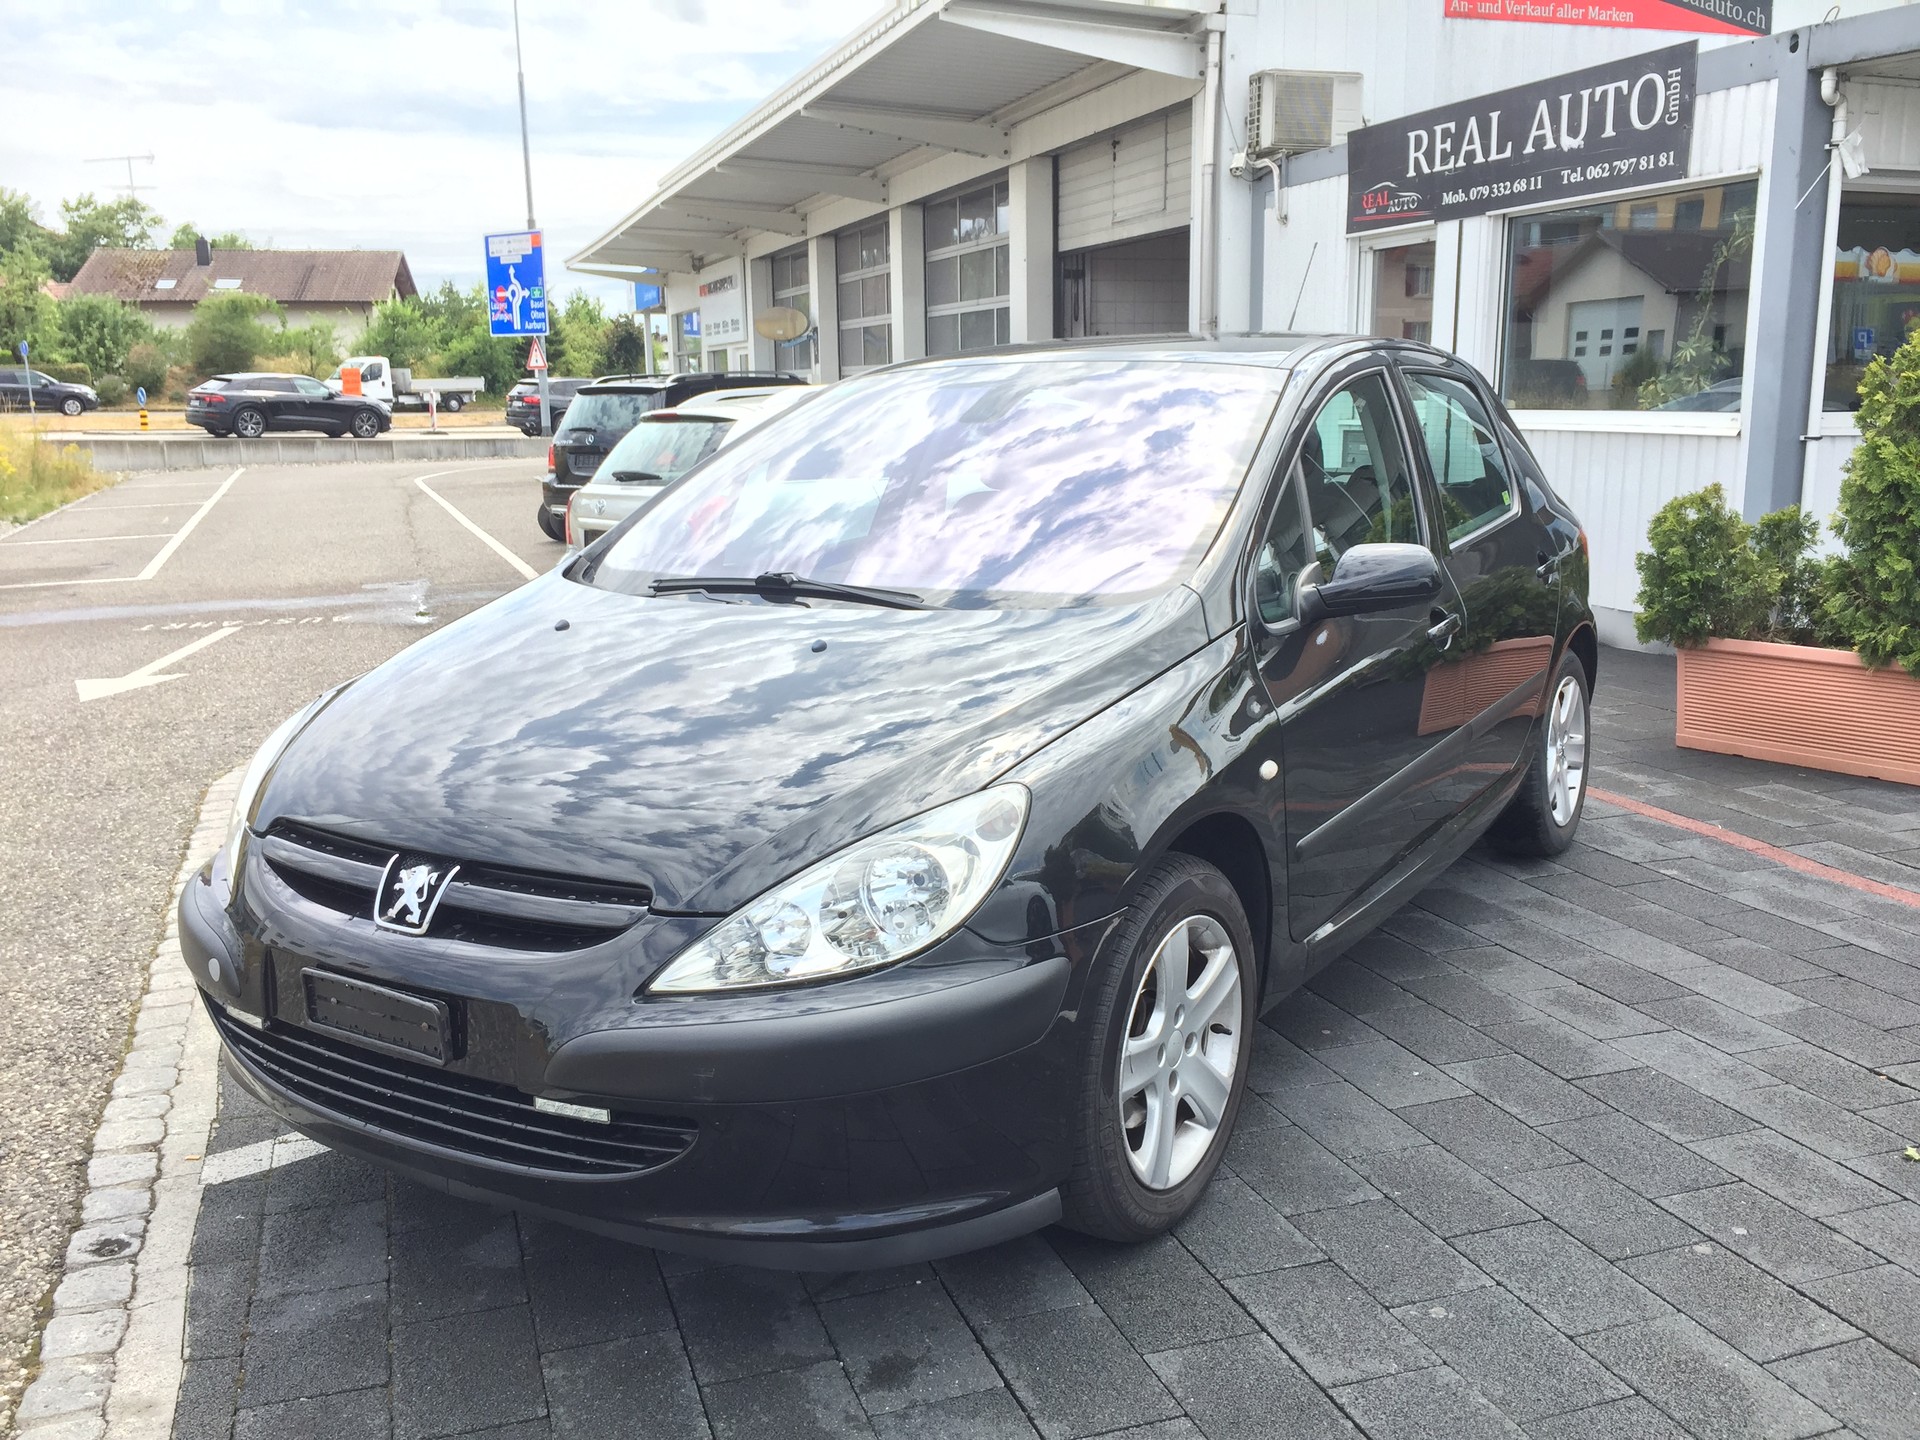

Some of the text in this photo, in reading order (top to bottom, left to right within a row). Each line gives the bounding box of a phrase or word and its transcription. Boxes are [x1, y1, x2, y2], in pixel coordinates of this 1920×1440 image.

[1450, 0, 1634, 22] An- und Verkauf aller Marken
[1683, 0, 1766, 29] alauto.ch
[1664, 67, 1682, 125] GmbH
[1405, 72, 1667, 178] REAL AUTO
[1560, 150, 1675, 185] Tel. 062 797 81 81
[1362, 191, 1390, 209] REAL
[1441, 175, 1543, 206] Mob. 079 332 68 11
[1387, 195, 1418, 213] AUTO
[530, 299, 545, 309] Basel
[530, 310, 545, 320] Olten
[525, 320, 546, 331] Aarburg
